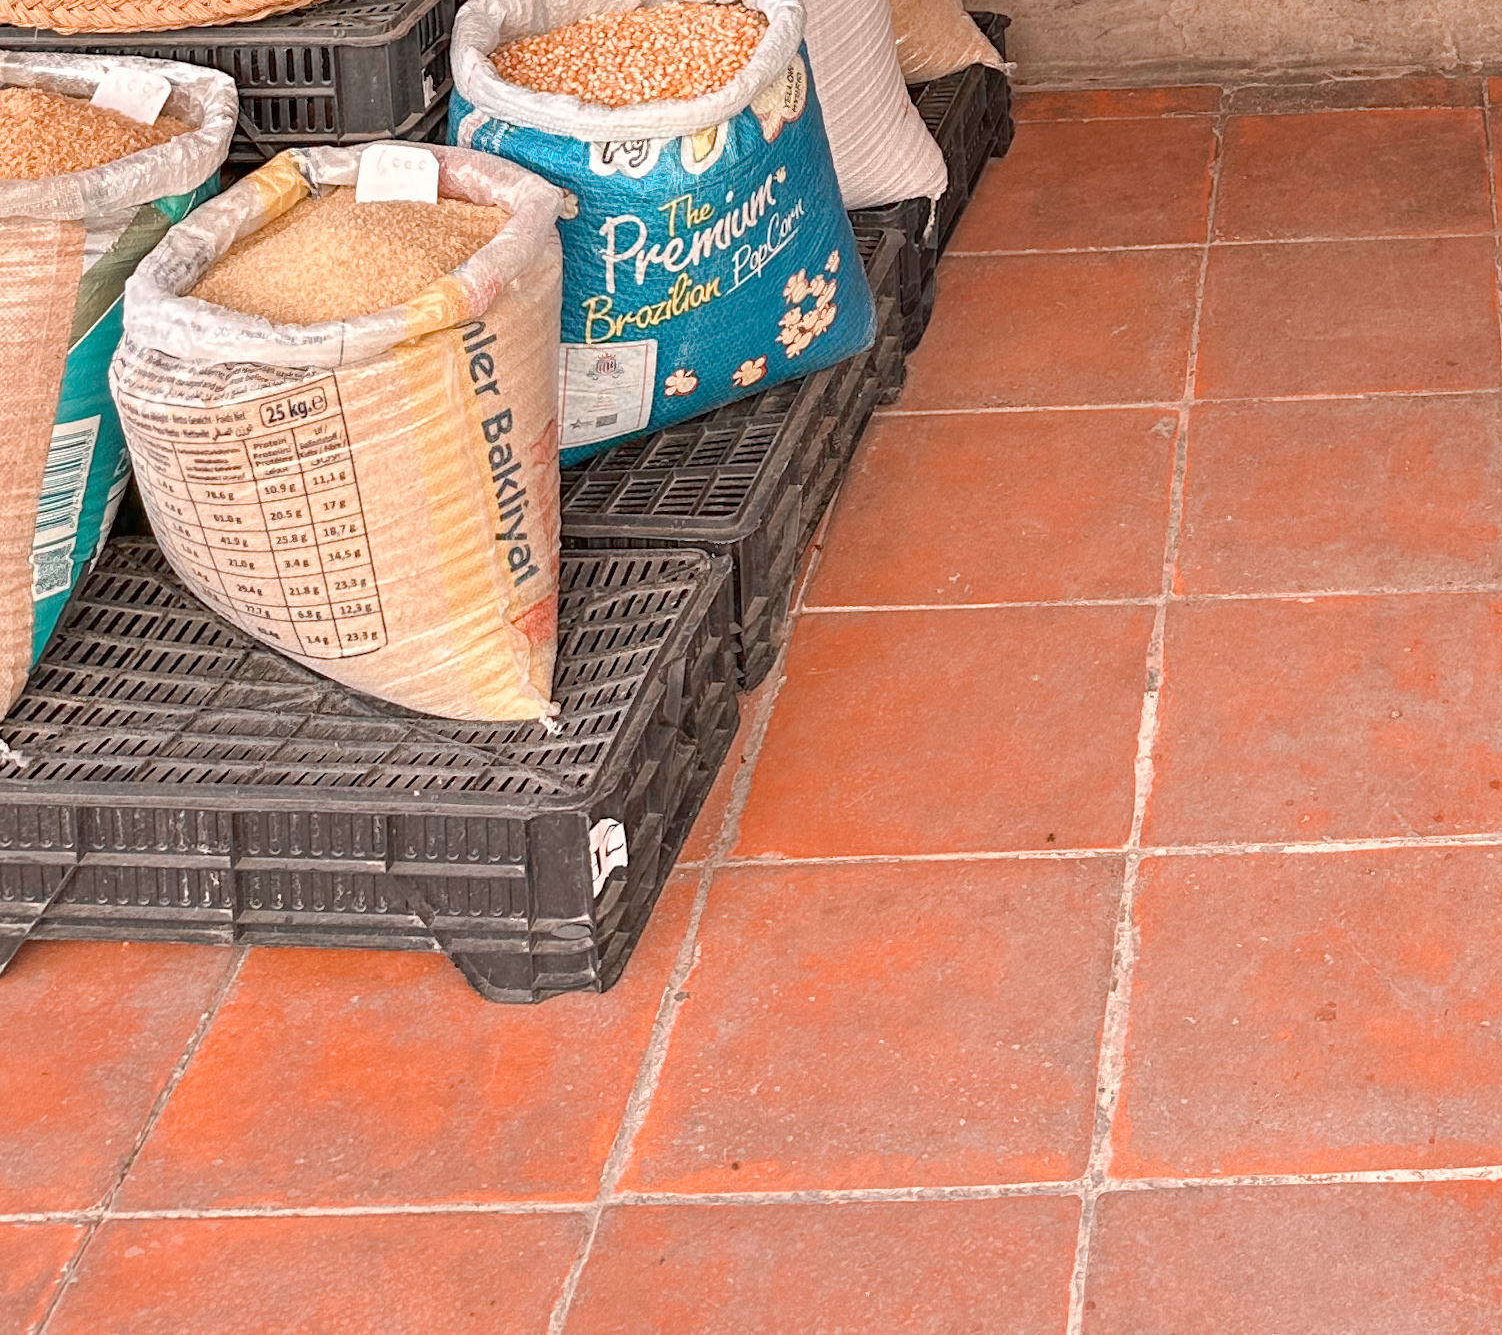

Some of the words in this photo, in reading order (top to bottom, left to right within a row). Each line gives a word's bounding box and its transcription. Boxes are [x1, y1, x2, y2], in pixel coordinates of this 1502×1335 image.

[658, 193, 715, 237] The
[599, 174, 777, 294] Premium
[582, 272, 721, 345] Brazilian
[265, 403, 285, 424] 25
[270, 509, 293, 521] 20.5
[323, 500, 336, 511] 17
